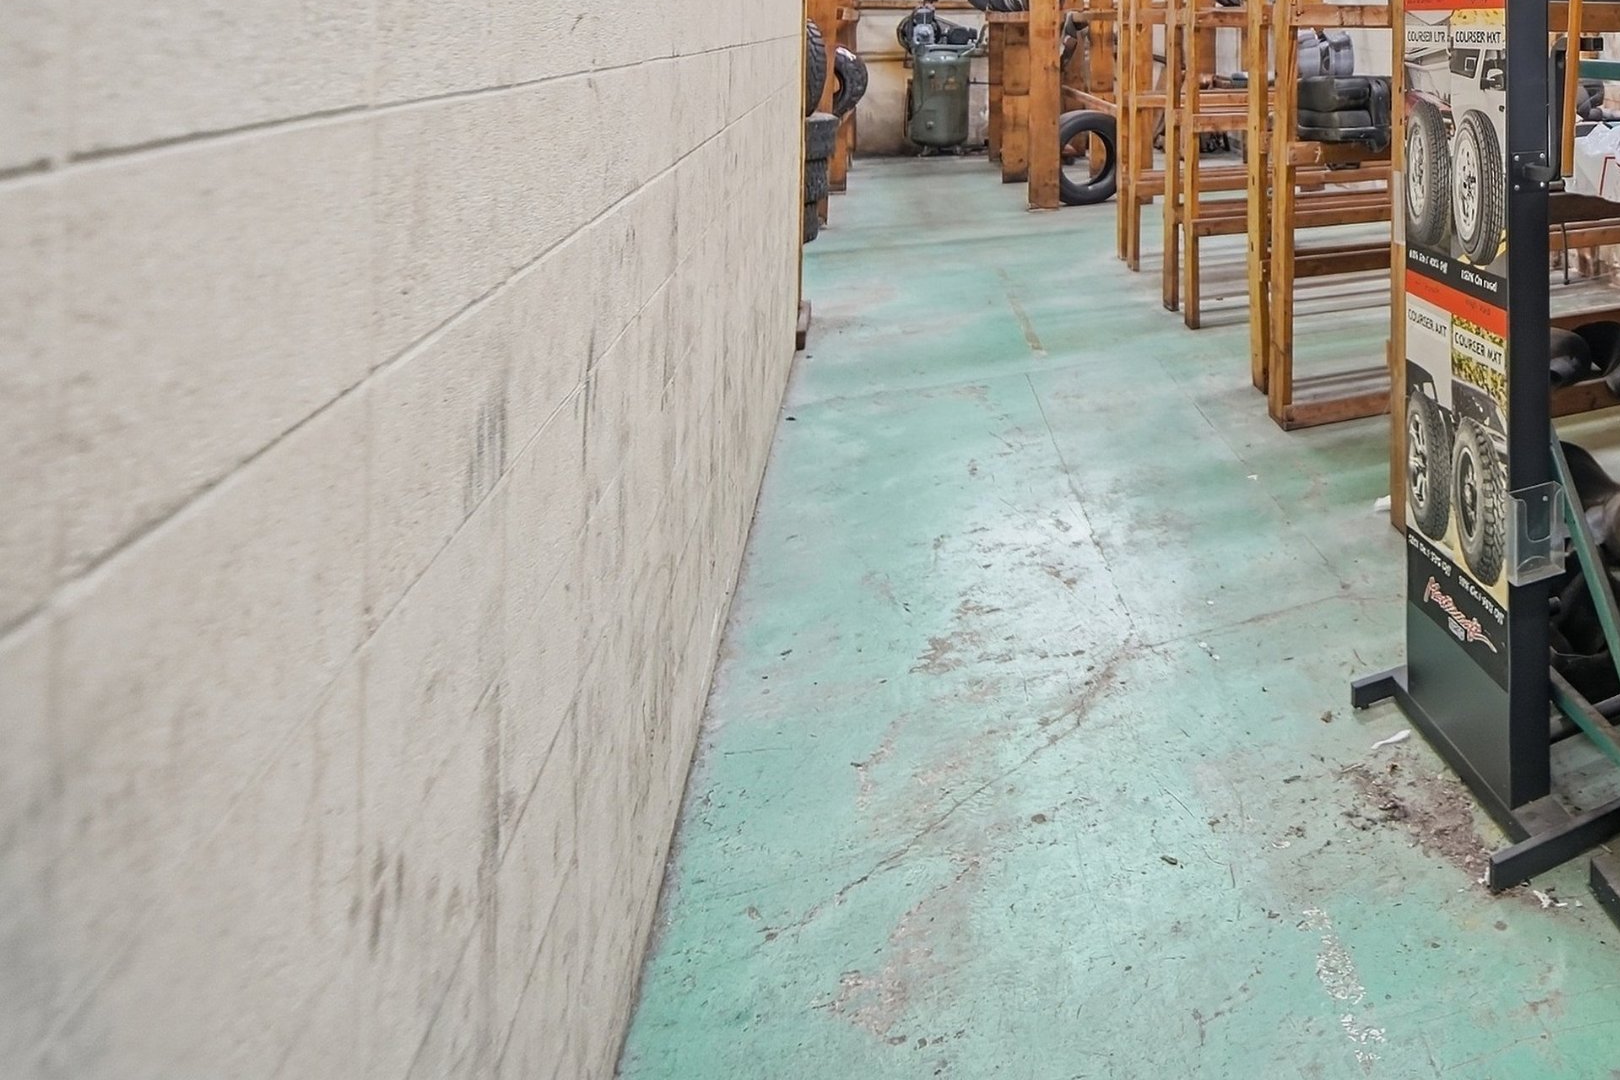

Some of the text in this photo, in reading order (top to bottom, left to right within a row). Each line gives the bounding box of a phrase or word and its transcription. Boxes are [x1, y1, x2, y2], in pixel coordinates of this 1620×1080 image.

[1455, 30, 1486, 43] COURSER
[1408, 308, 1434, 332] COURSER
[1454, 332, 1486, 358] COURSER
